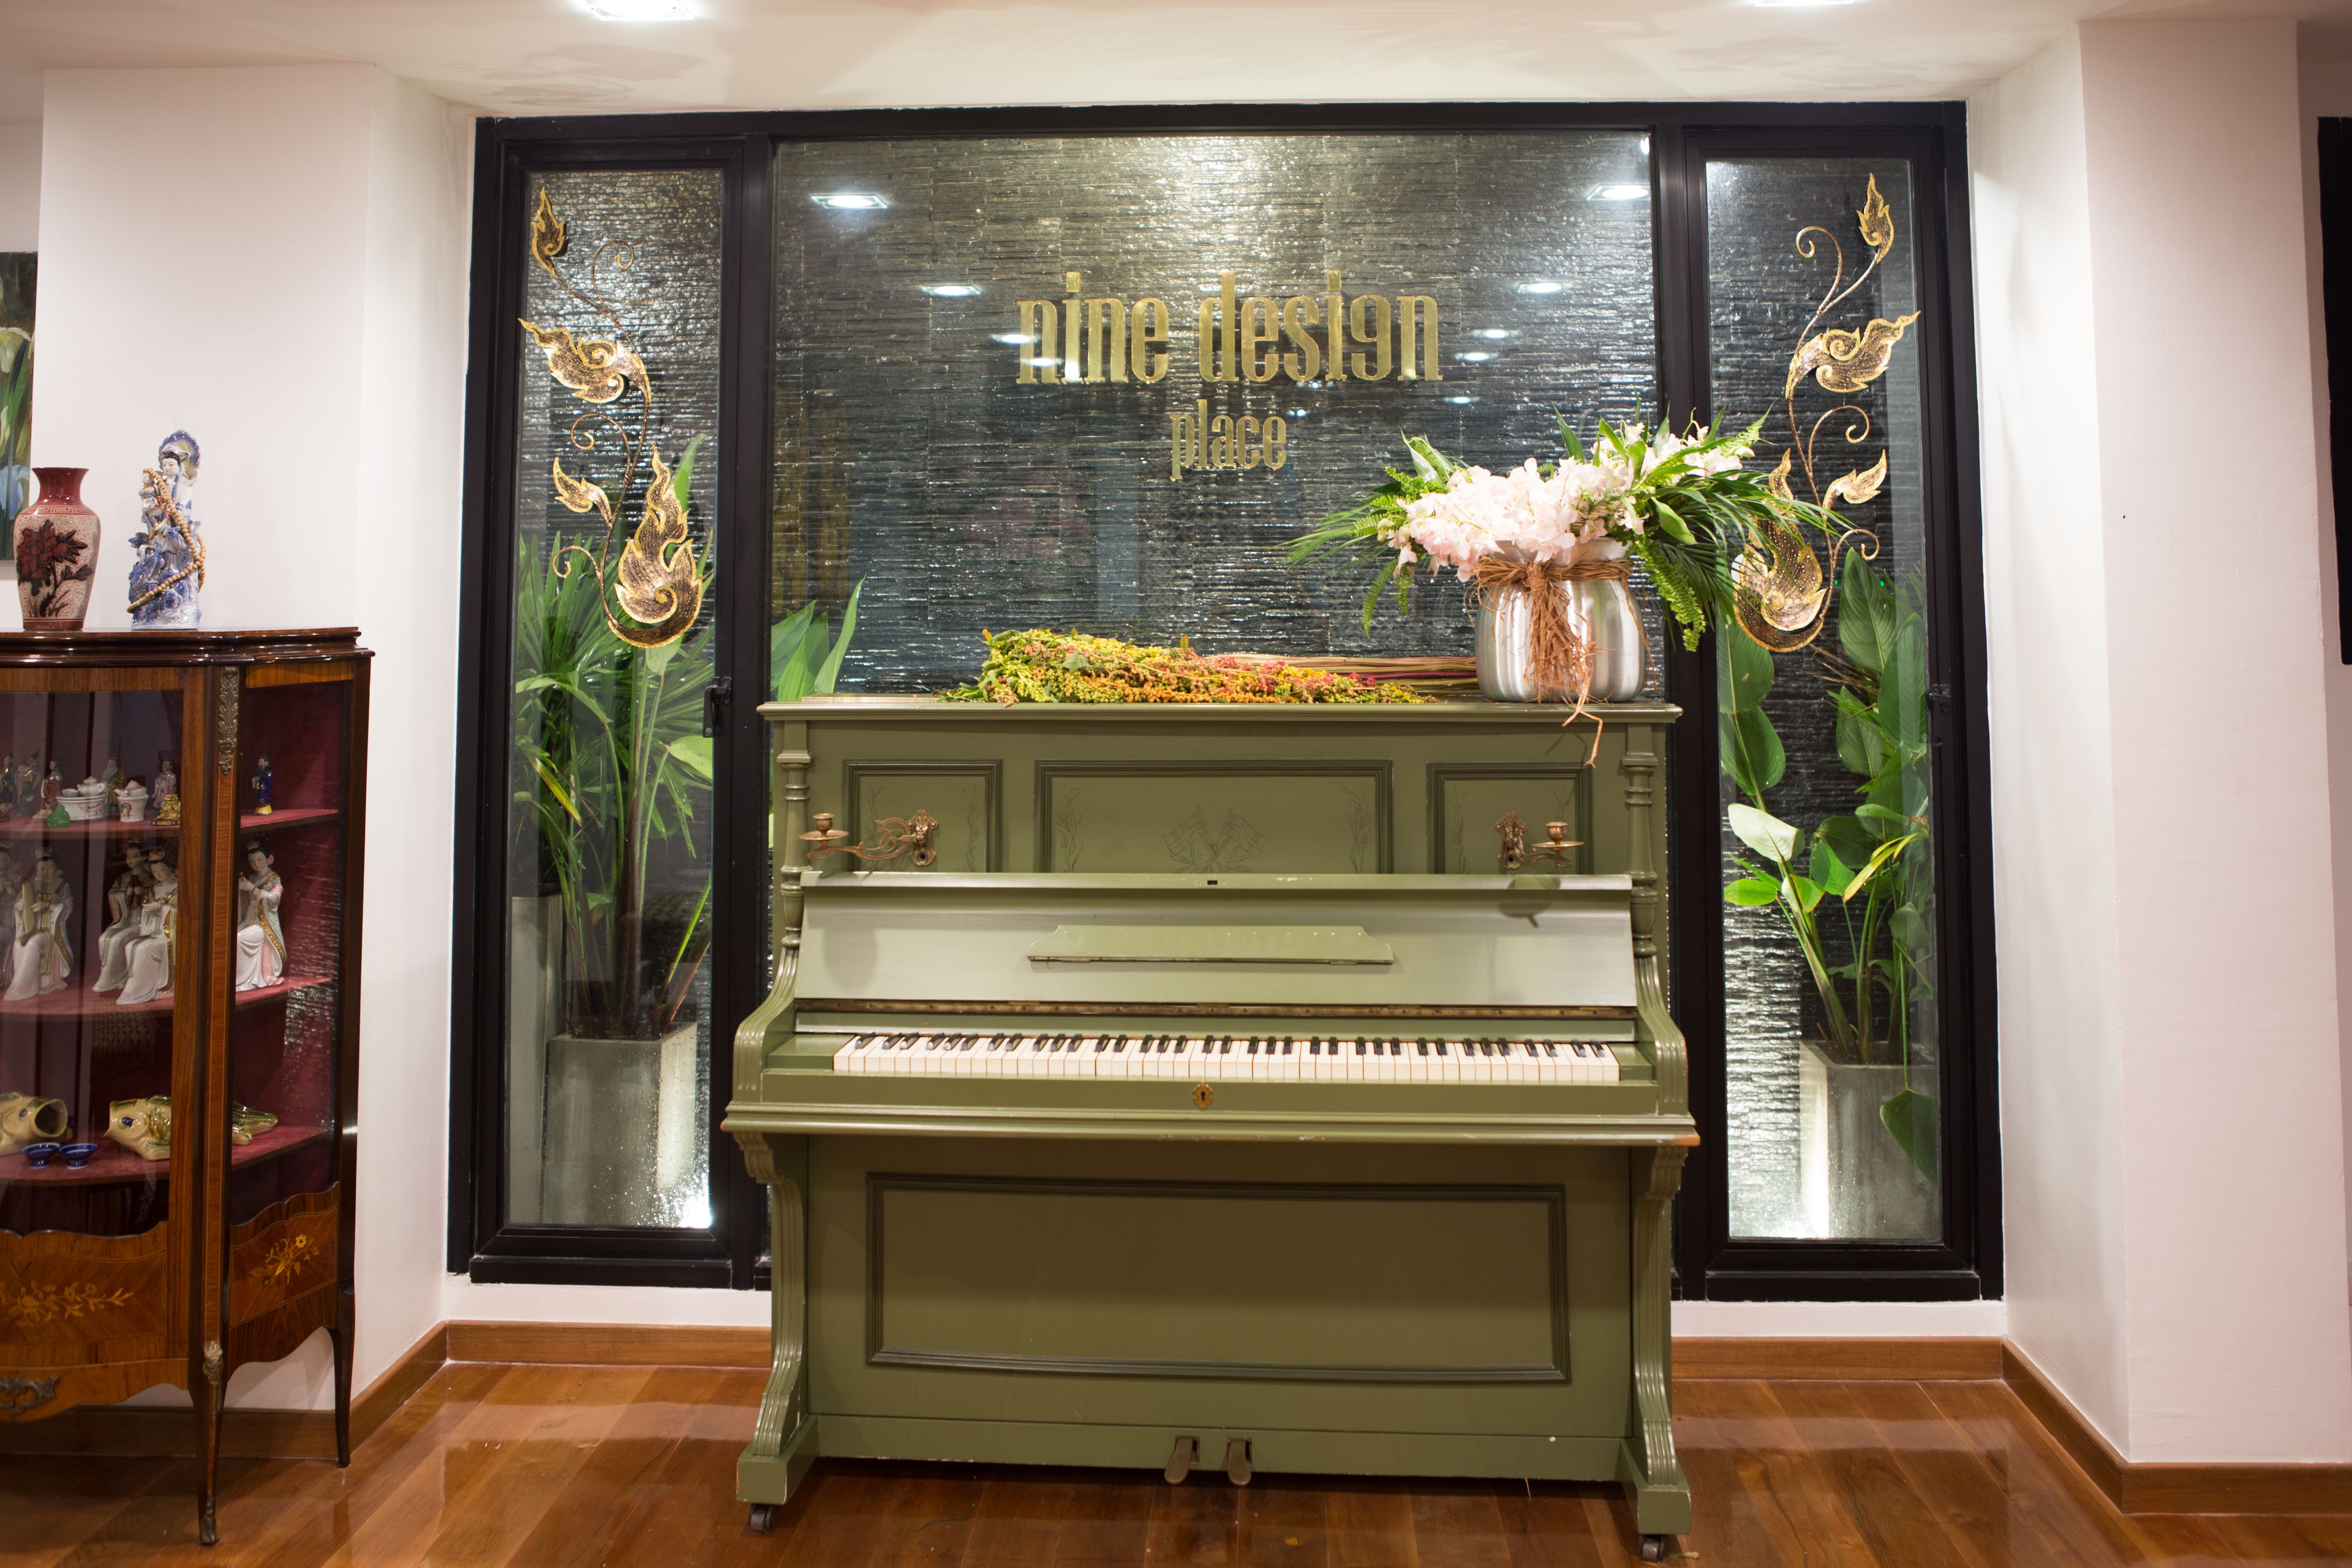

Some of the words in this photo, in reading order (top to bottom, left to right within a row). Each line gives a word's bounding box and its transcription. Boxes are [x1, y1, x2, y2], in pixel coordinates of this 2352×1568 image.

[1016, 271, 1170, 385] nine
[1199, 270, 1444, 383] design
[1170, 399, 1286, 481] place
